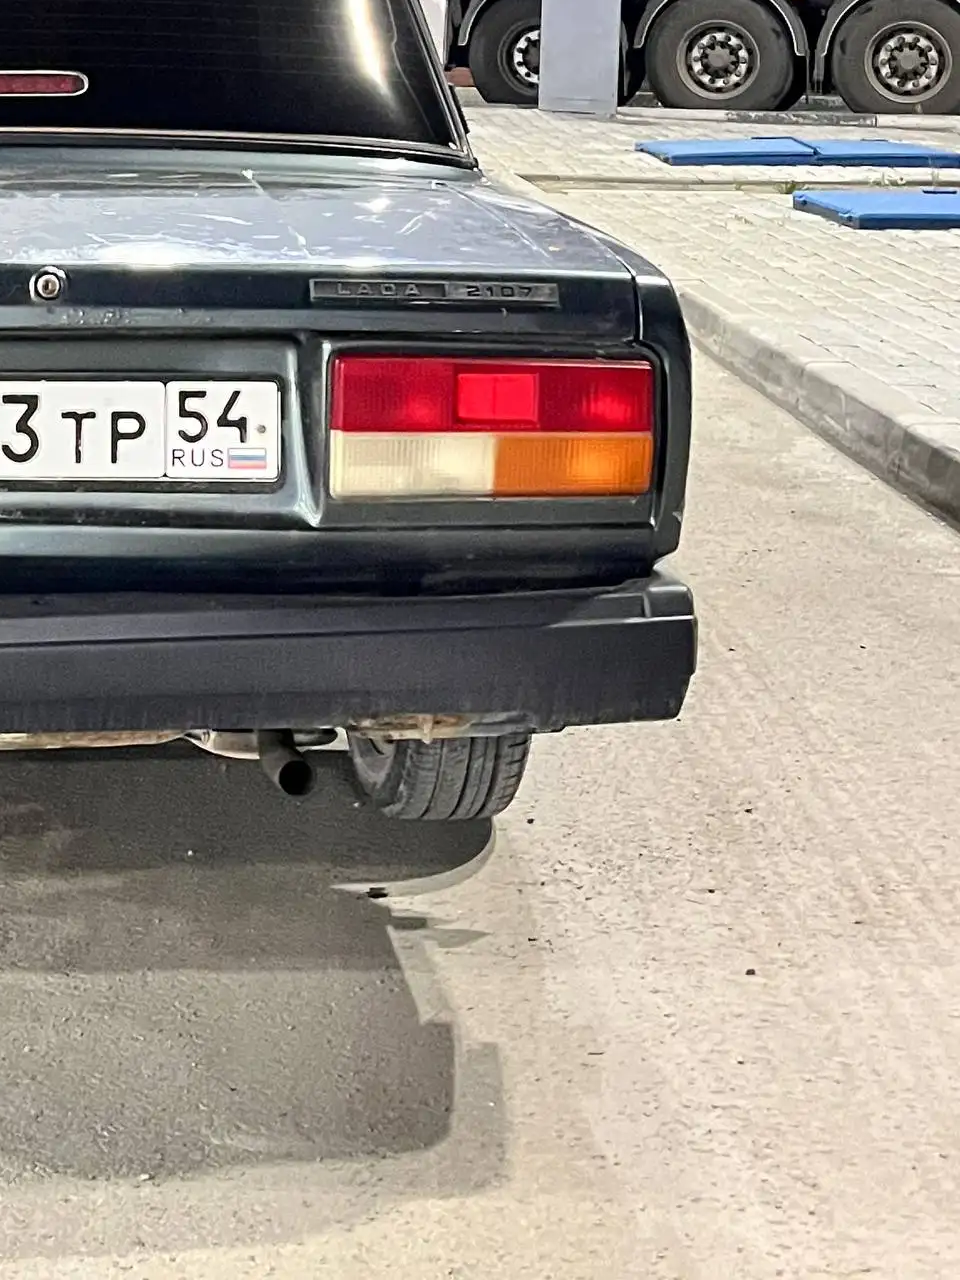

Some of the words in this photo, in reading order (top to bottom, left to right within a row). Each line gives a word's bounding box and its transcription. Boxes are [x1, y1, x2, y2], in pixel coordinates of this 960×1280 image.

[337, 281, 422, 296] LADA
[466, 284, 533, 298] 2107
[177, 390, 248, 444] 54
[171, 448, 224, 467] RUS
